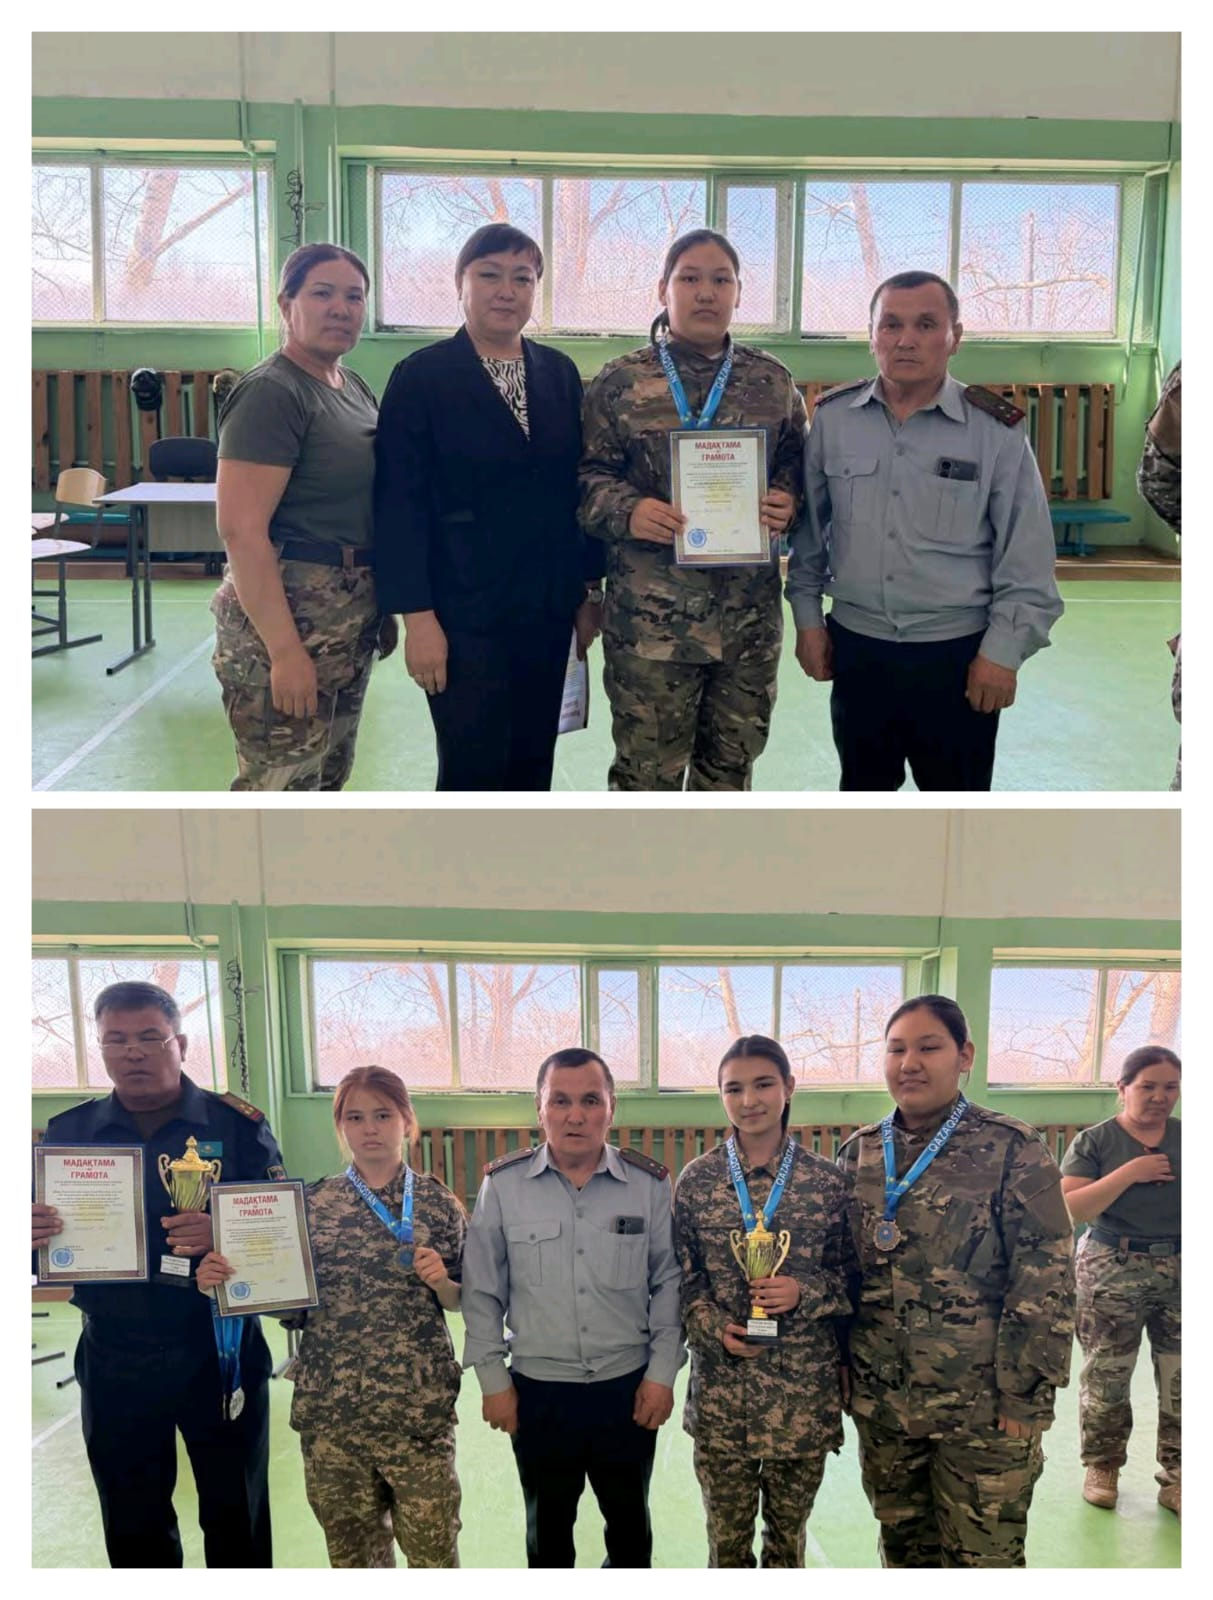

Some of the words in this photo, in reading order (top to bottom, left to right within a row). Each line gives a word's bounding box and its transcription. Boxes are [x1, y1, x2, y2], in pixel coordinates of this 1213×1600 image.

[702, 453, 735, 461] ГРАМОТА
[927, 1101, 968, 1153] QAZAQSTAN
[63, 1159, 116, 1168] МАДАҚТАМА
[70, 1171, 109, 1179] ГРАМОТА
[232, 1194, 279, 1206] МАДАҚТАМА
[239, 1208, 274, 1217] ГРАМОТА
